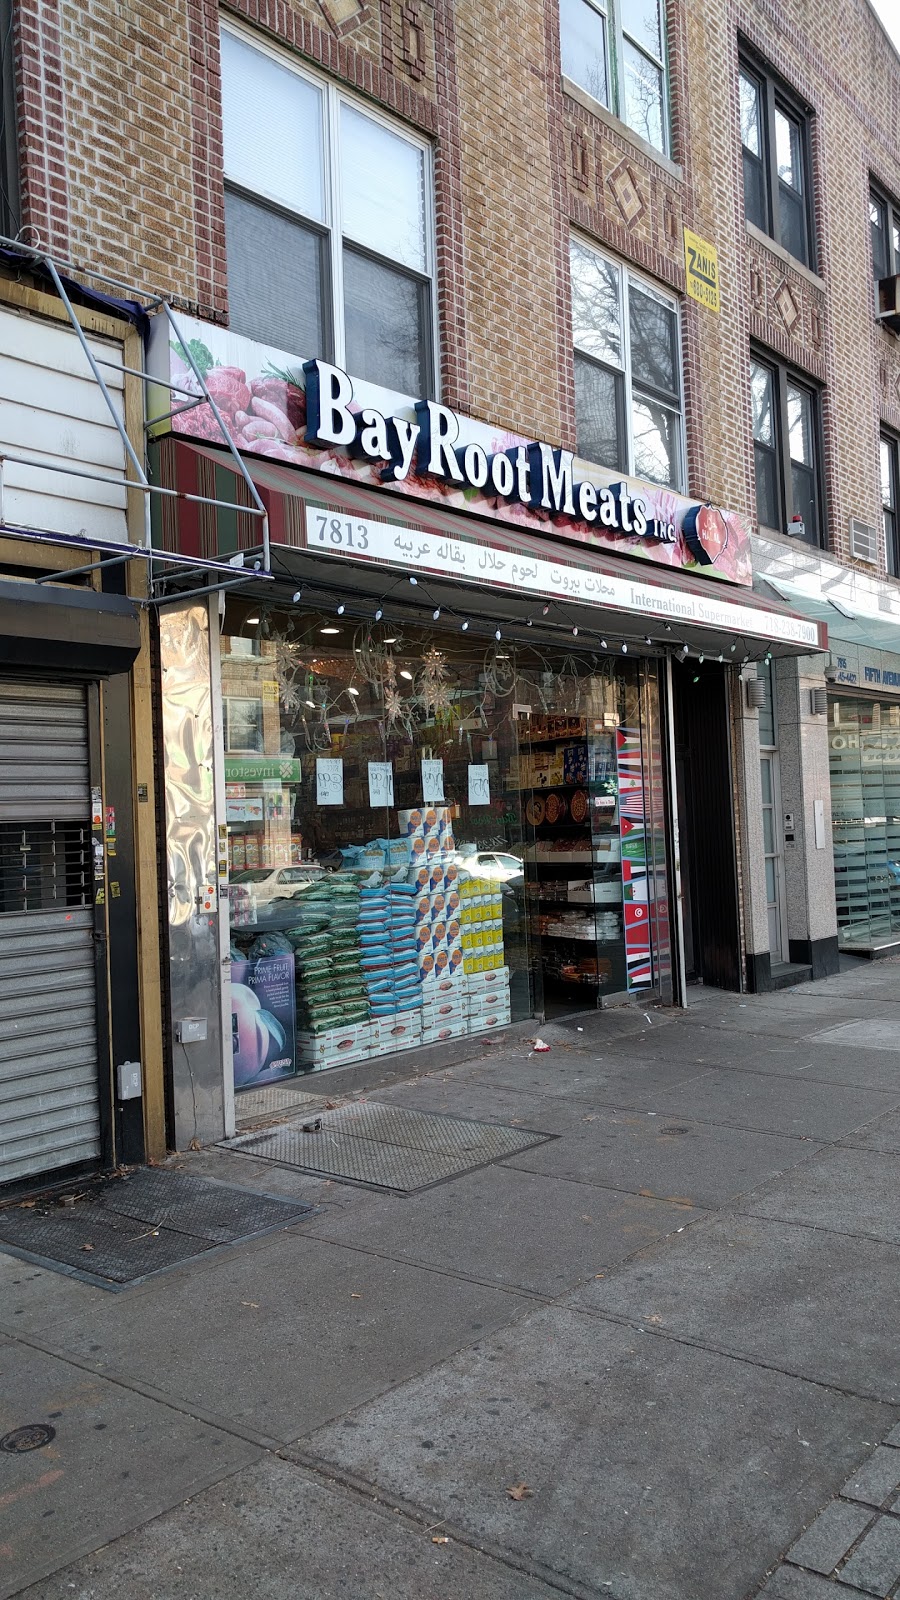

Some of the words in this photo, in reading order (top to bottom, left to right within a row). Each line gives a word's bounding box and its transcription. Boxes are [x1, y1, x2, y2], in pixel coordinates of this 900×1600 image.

[687, 245, 717, 288] ZANIS
[304, 358, 421, 482] Bay
[416, 399, 533, 503] Root
[528, 441, 648, 536] Meats
[315, 514, 370, 550] 7813
[478, 549, 506, 571] حلال
[511, 562, 539, 583] لحوم
[550, 571, 581, 594] بيروت
[629, 587, 697, 618] International
[698, 602, 754, 630] Supermarket
[763, 615, 816, 643] 718-238-7900
[864, 666, 881, 684] FIFTH
[247, 974, 267, 985] PRIMA
[268, 971, 290, 982] FLAVOR
[253, 964, 272, 976] PRIME
